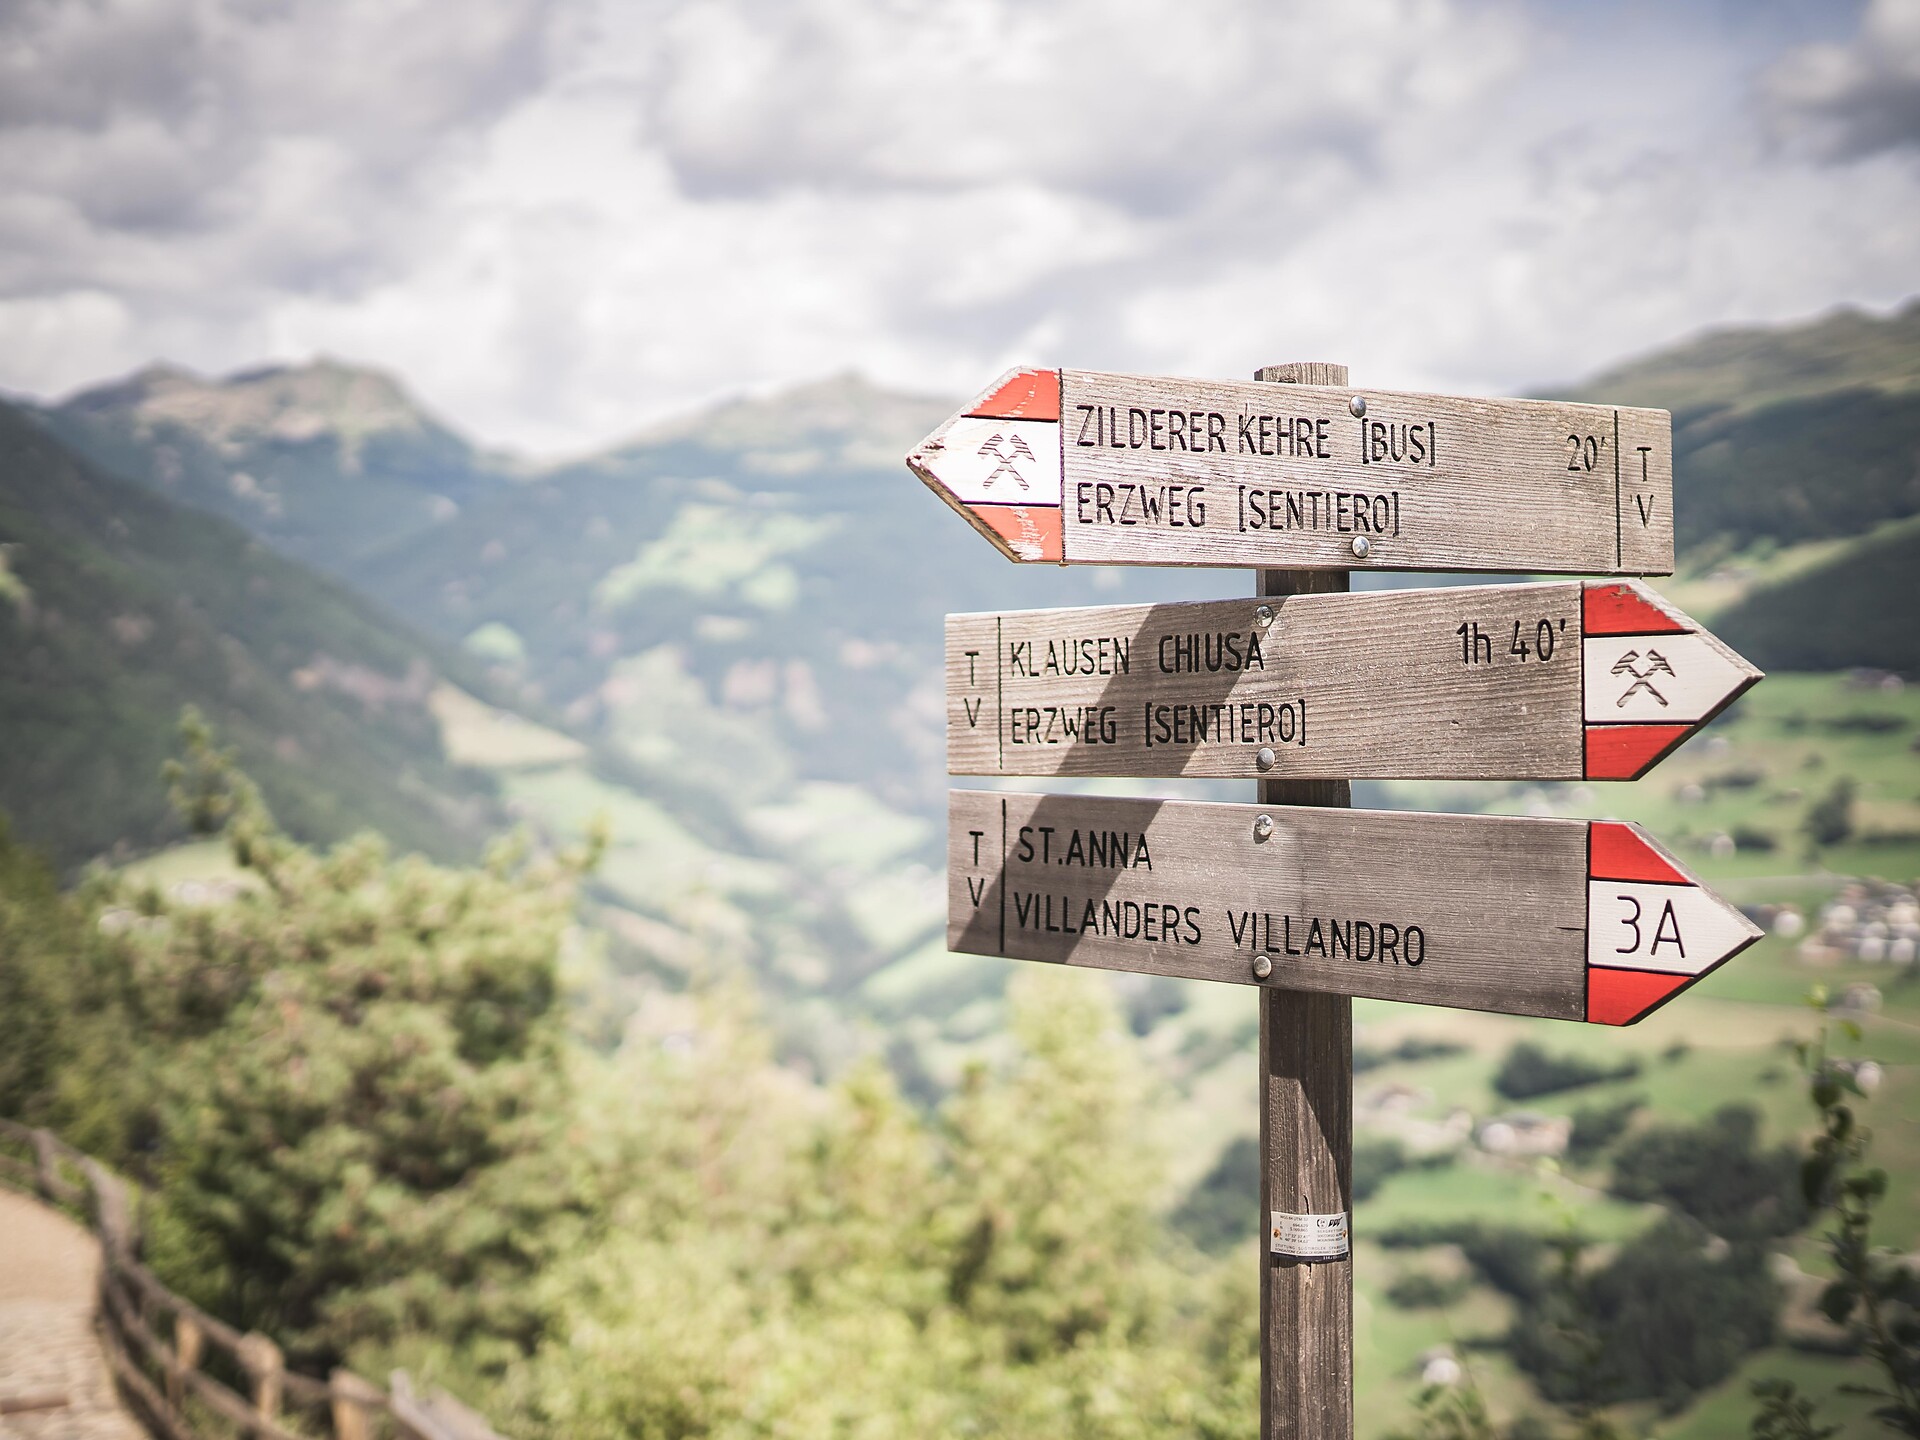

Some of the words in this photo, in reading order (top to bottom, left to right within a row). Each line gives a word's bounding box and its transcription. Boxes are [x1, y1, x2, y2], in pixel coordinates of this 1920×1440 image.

[1075, 404, 1227, 453] ZILDERER
[1238, 412, 1331, 459] KEHRE
[1361, 417, 1436, 467] [BUS]
[1566, 434, 1608, 472] 20'
[1636, 446, 1652, 483] T
[1076, 482, 1206, 528] ERZWEG
[1238, 484, 1401, 538] [SENTIERO]
[1636, 494, 1655, 529] V
[1010, 636, 1130, 677] KLAUSEN
[1158, 631, 1265, 674] CHIUSA
[1456, 622, 1492, 665] 1h
[1510, 617, 1566, 663] 40'
[964, 651, 980, 686] T
[963, 697, 981, 728] V
[1011, 705, 1118, 745] ERZWEG
[1145, 699, 1307, 748] [SENTIERO]
[969, 830, 985, 866] T
[1016, 825, 1154, 872] ST.ANNA
[967, 875, 985, 912] V
[1013, 890, 1203, 945] VILLANDERS
[1226, 909, 1426, 968] VILLANDRO
[1615, 894, 1686, 960] 3A
